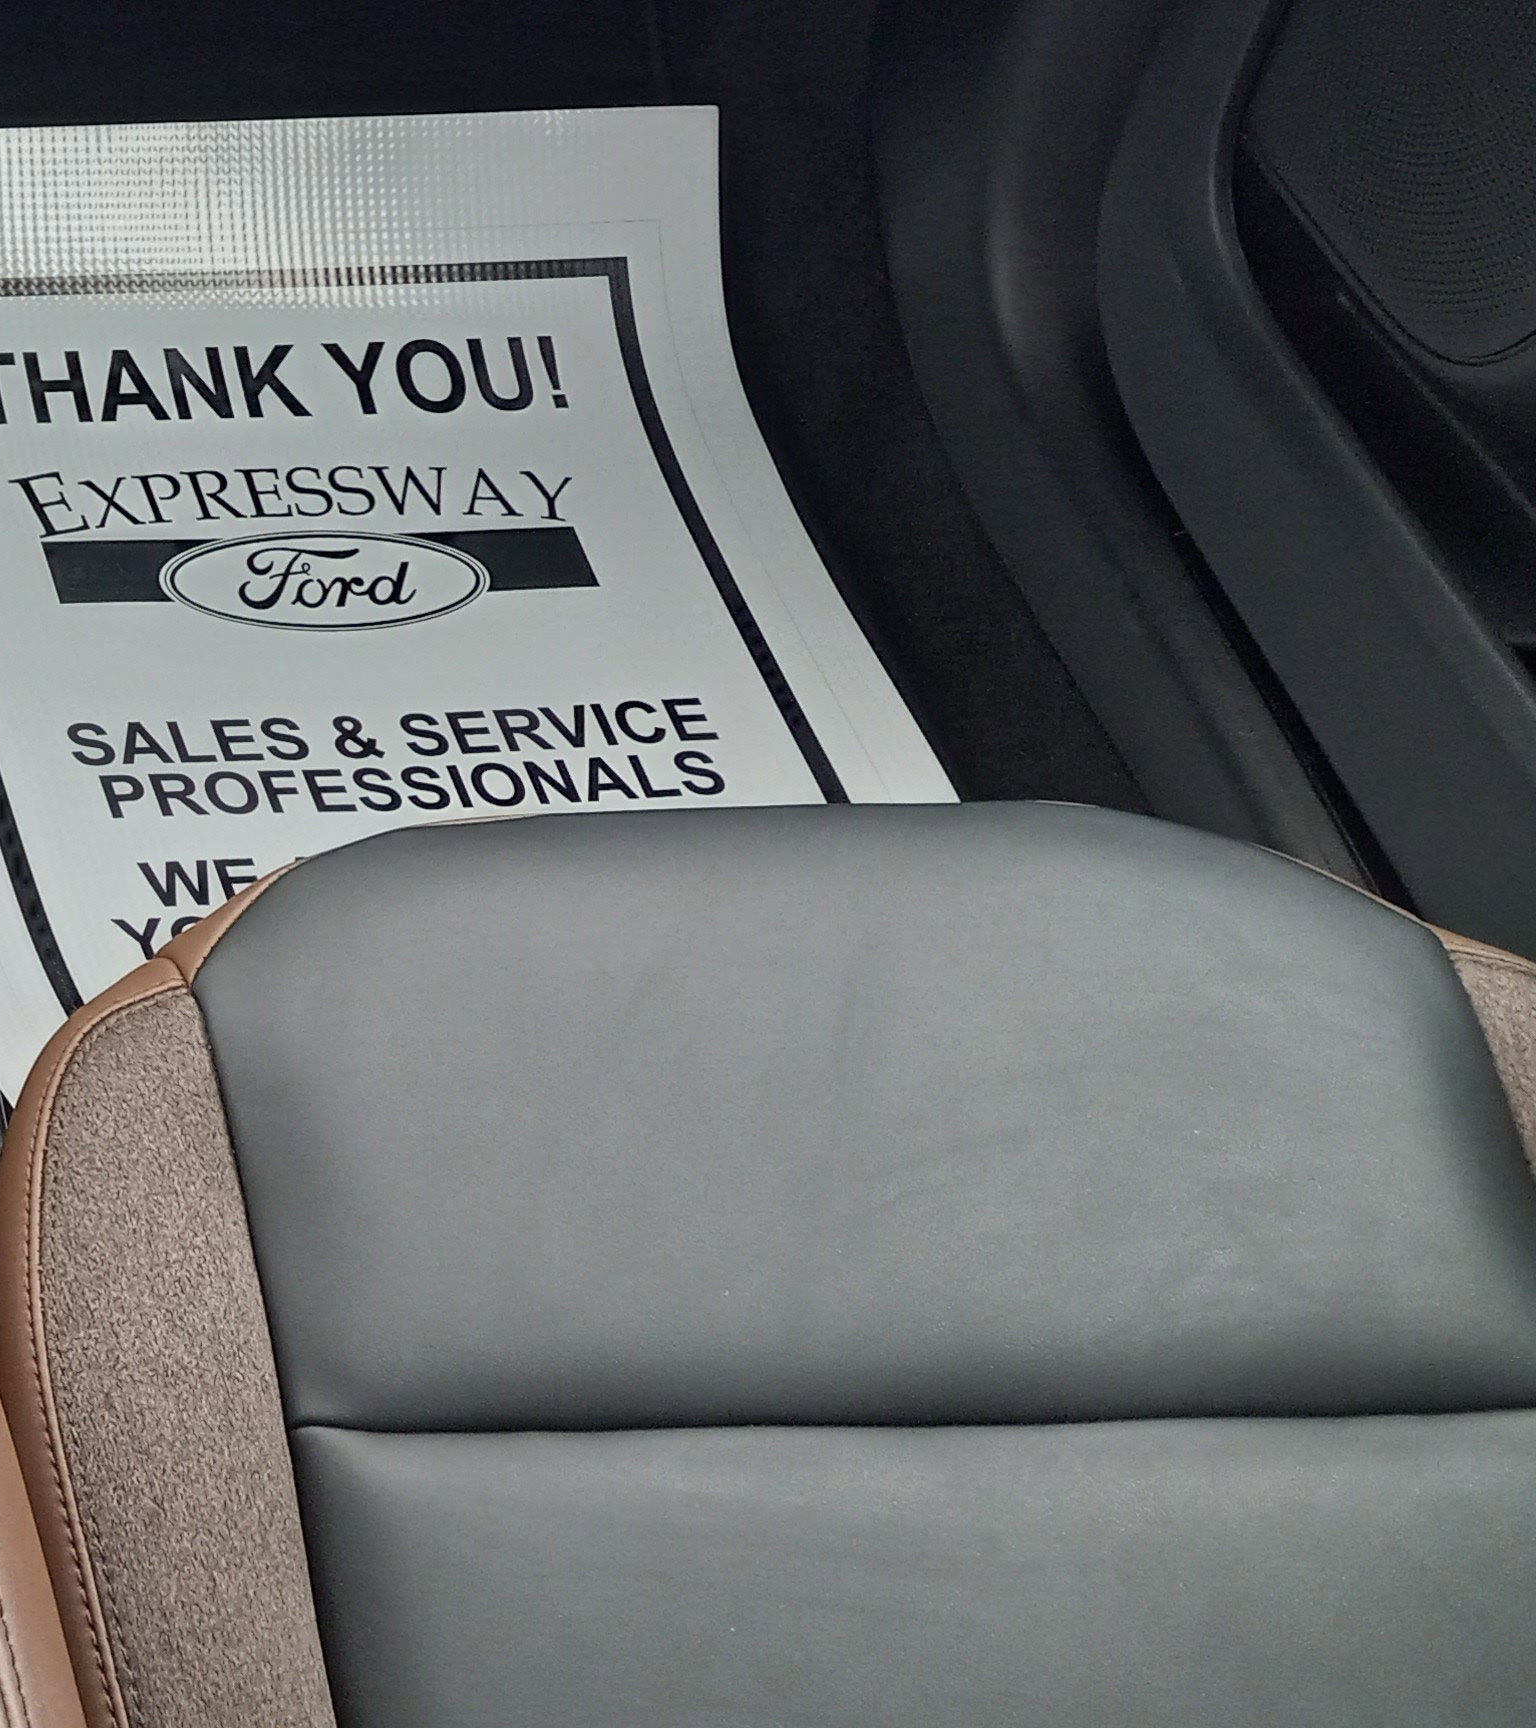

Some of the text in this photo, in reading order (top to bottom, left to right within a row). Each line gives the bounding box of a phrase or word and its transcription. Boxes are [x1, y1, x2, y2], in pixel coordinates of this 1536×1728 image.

[321, 334, 570, 416] YOU!
[9, 465, 573, 540] EXPRESSWAY
[238, 545, 418, 611] Ford
[67, 698, 720, 767] SALES & SERVICE
[98, 749, 727, 819] PROFESSIONALS
